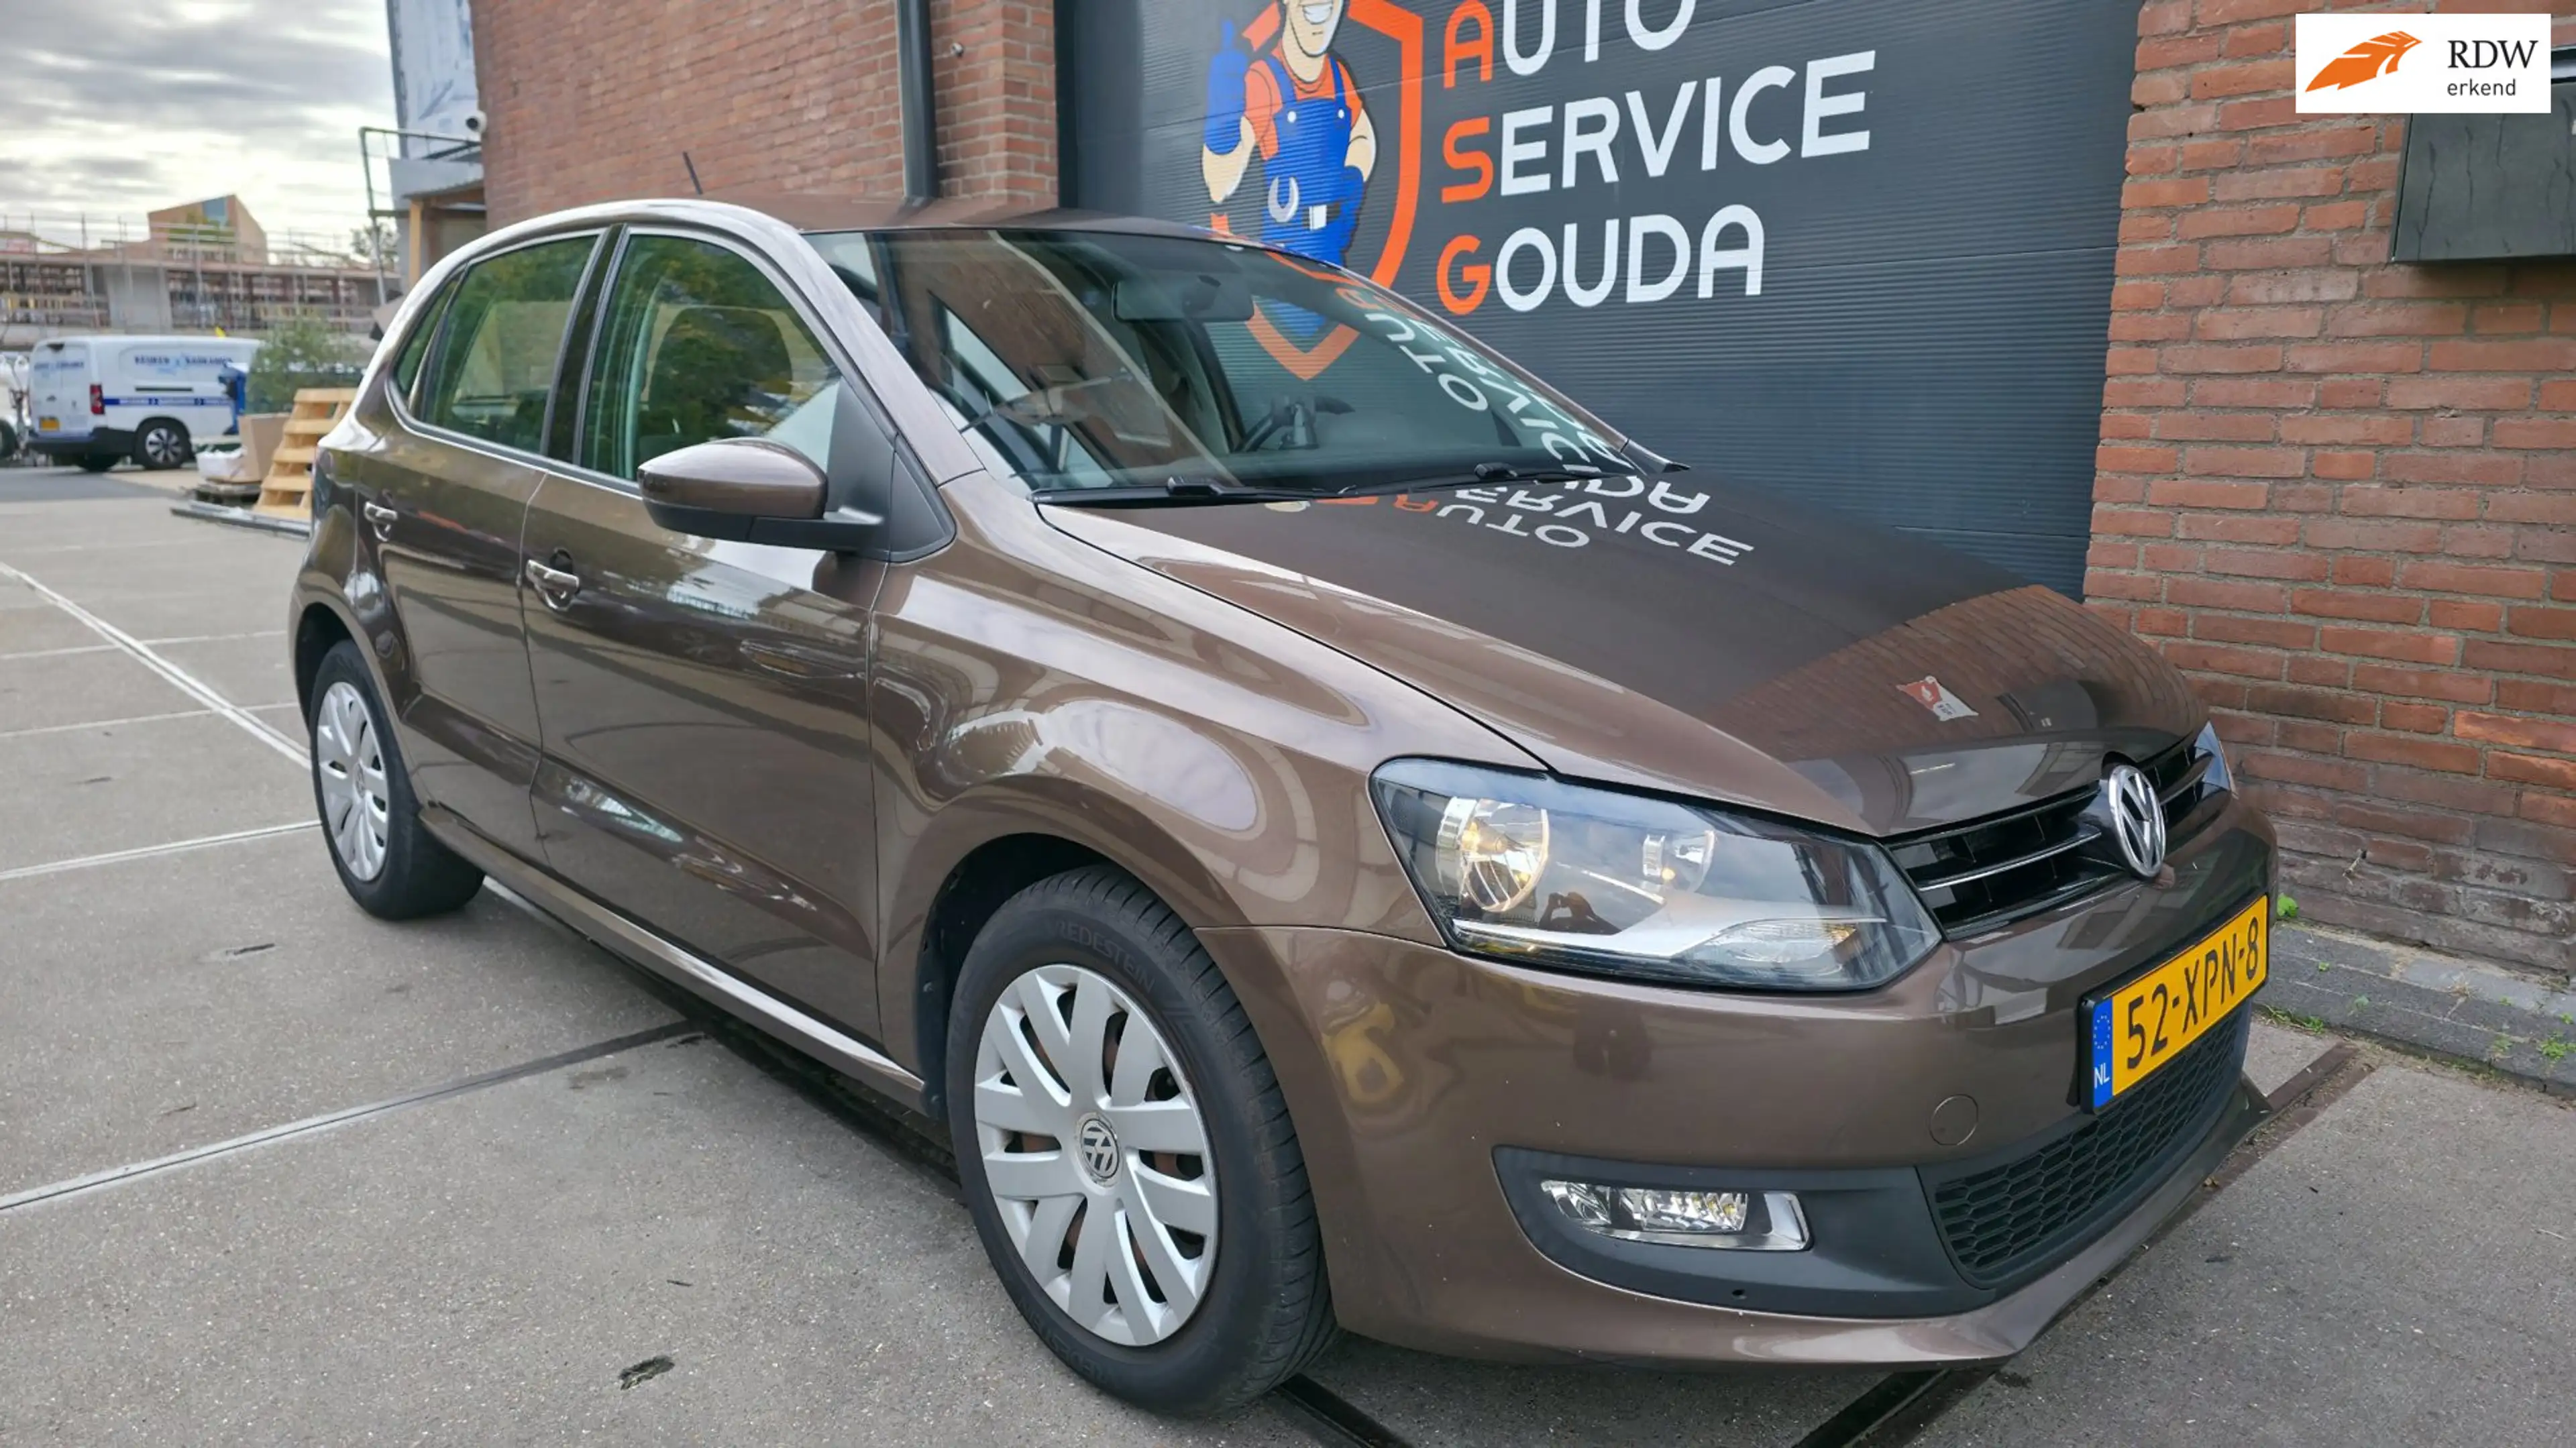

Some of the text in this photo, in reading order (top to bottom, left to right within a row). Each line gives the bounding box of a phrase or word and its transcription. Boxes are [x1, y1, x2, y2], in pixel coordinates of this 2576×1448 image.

[1442, 50, 1876, 204] SERVICE
[1436, 203, 1766, 316] GOUDA
[2127, 915, 2260, 1070] 52-XPN-8
[2093, 1062, 2110, 1089] NL
